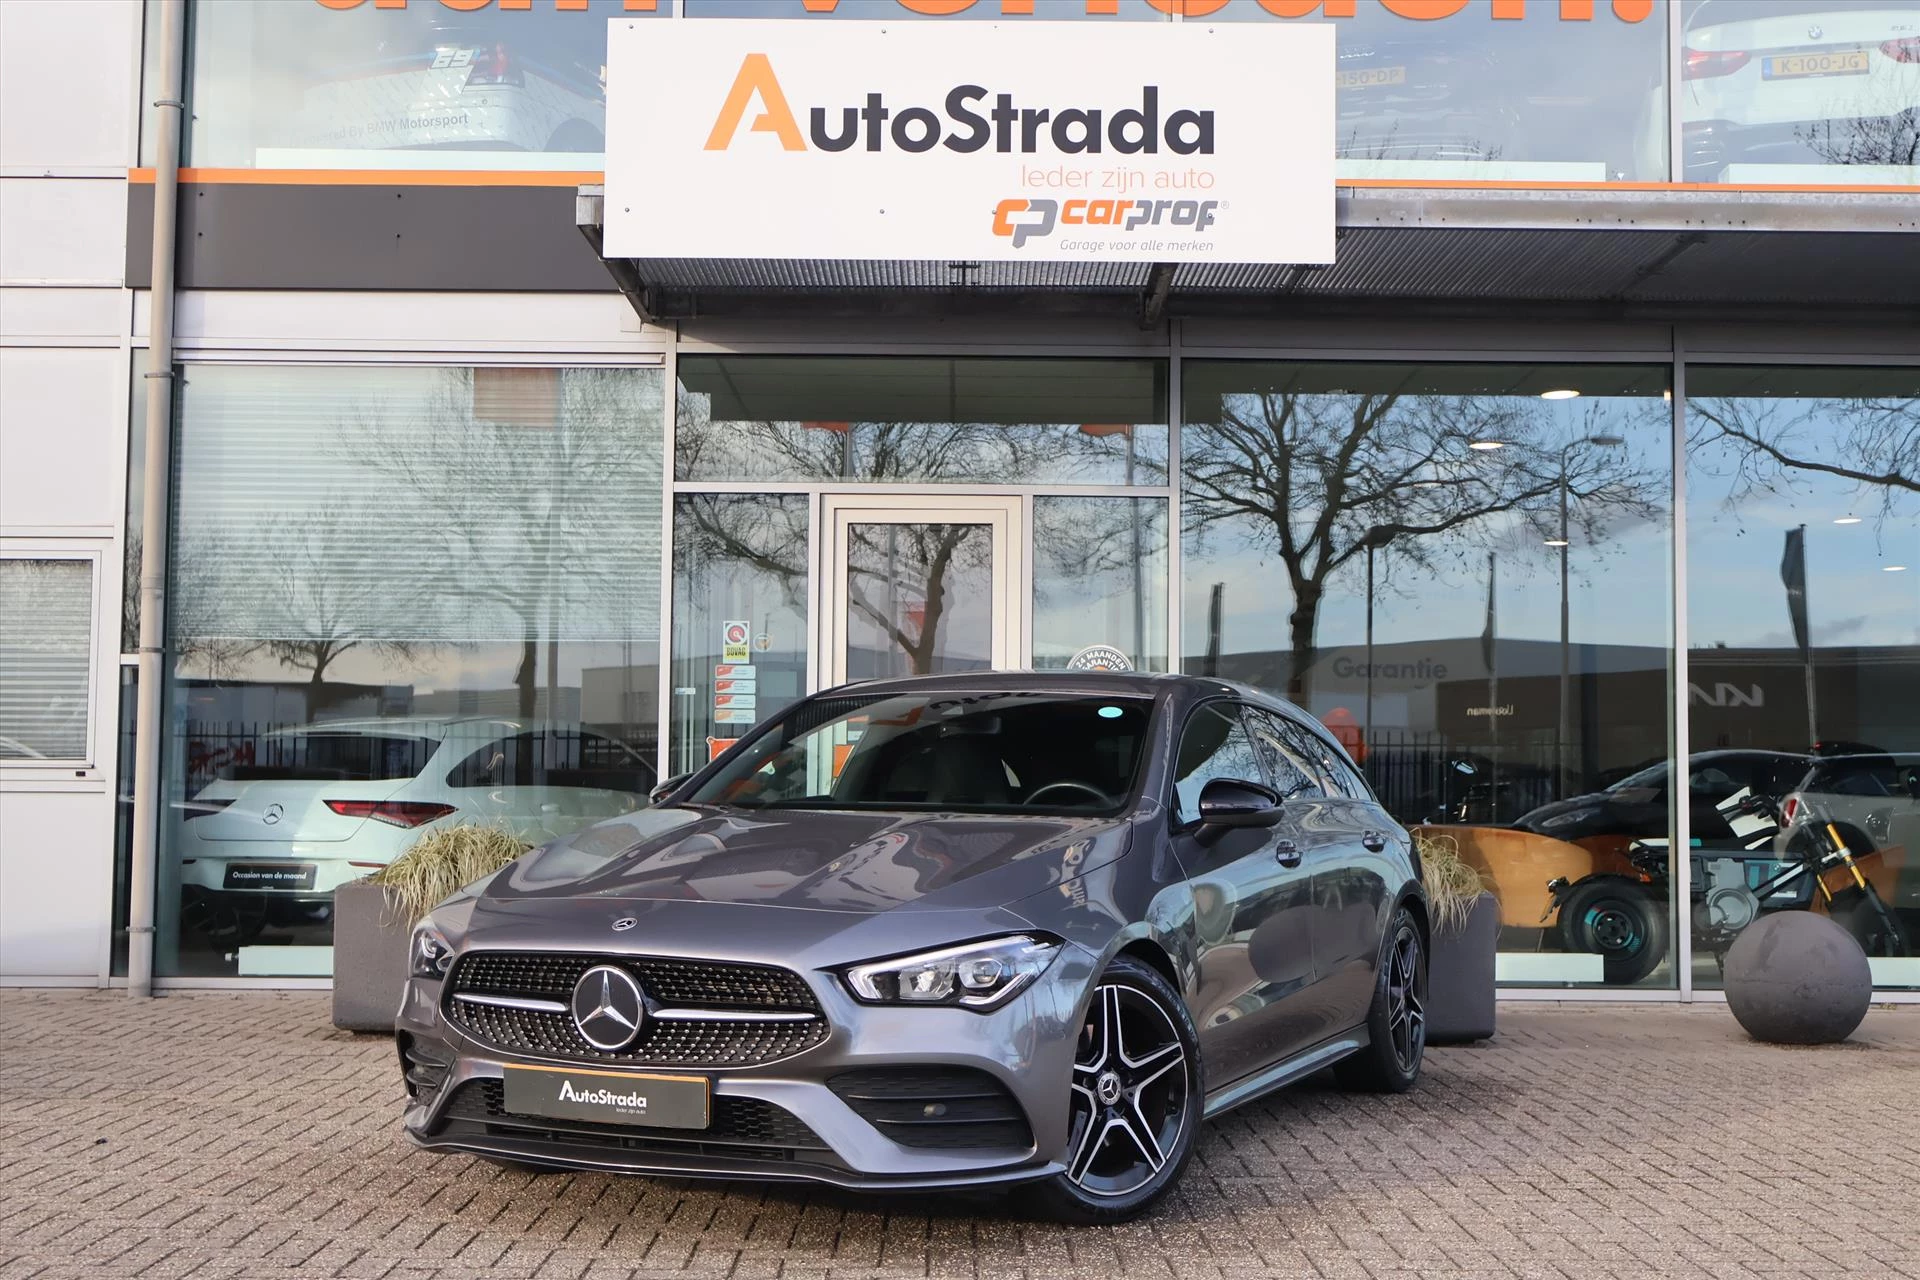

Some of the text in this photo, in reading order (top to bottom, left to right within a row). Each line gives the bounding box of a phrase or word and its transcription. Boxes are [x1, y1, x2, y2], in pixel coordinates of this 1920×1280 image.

[432, 49, 474, 69] 69
[1780, 54, 1860, 73] K-100-JG
[703, 53, 1214, 155] AutoStrada
[367, 120, 397, 135] BMW
[399, 113, 469, 131] Motorsport
[1022, 165, 1215, 194] Ieder zijn auto
[1061, 199, 1218, 232] carprof
[1060, 239, 1214, 253] Garage voor alle merken
[726, 646, 747, 657] BOVAG
[1075, 651, 1126, 670] 24 MAANDEN
[1332, 657, 1448, 680] Garantie
[232, 871, 261, 879] Occasion
[274, 871, 283, 879] de
[283, 872, 307, 880] maand
[558, 1080, 647, 1108] AutoStrada
